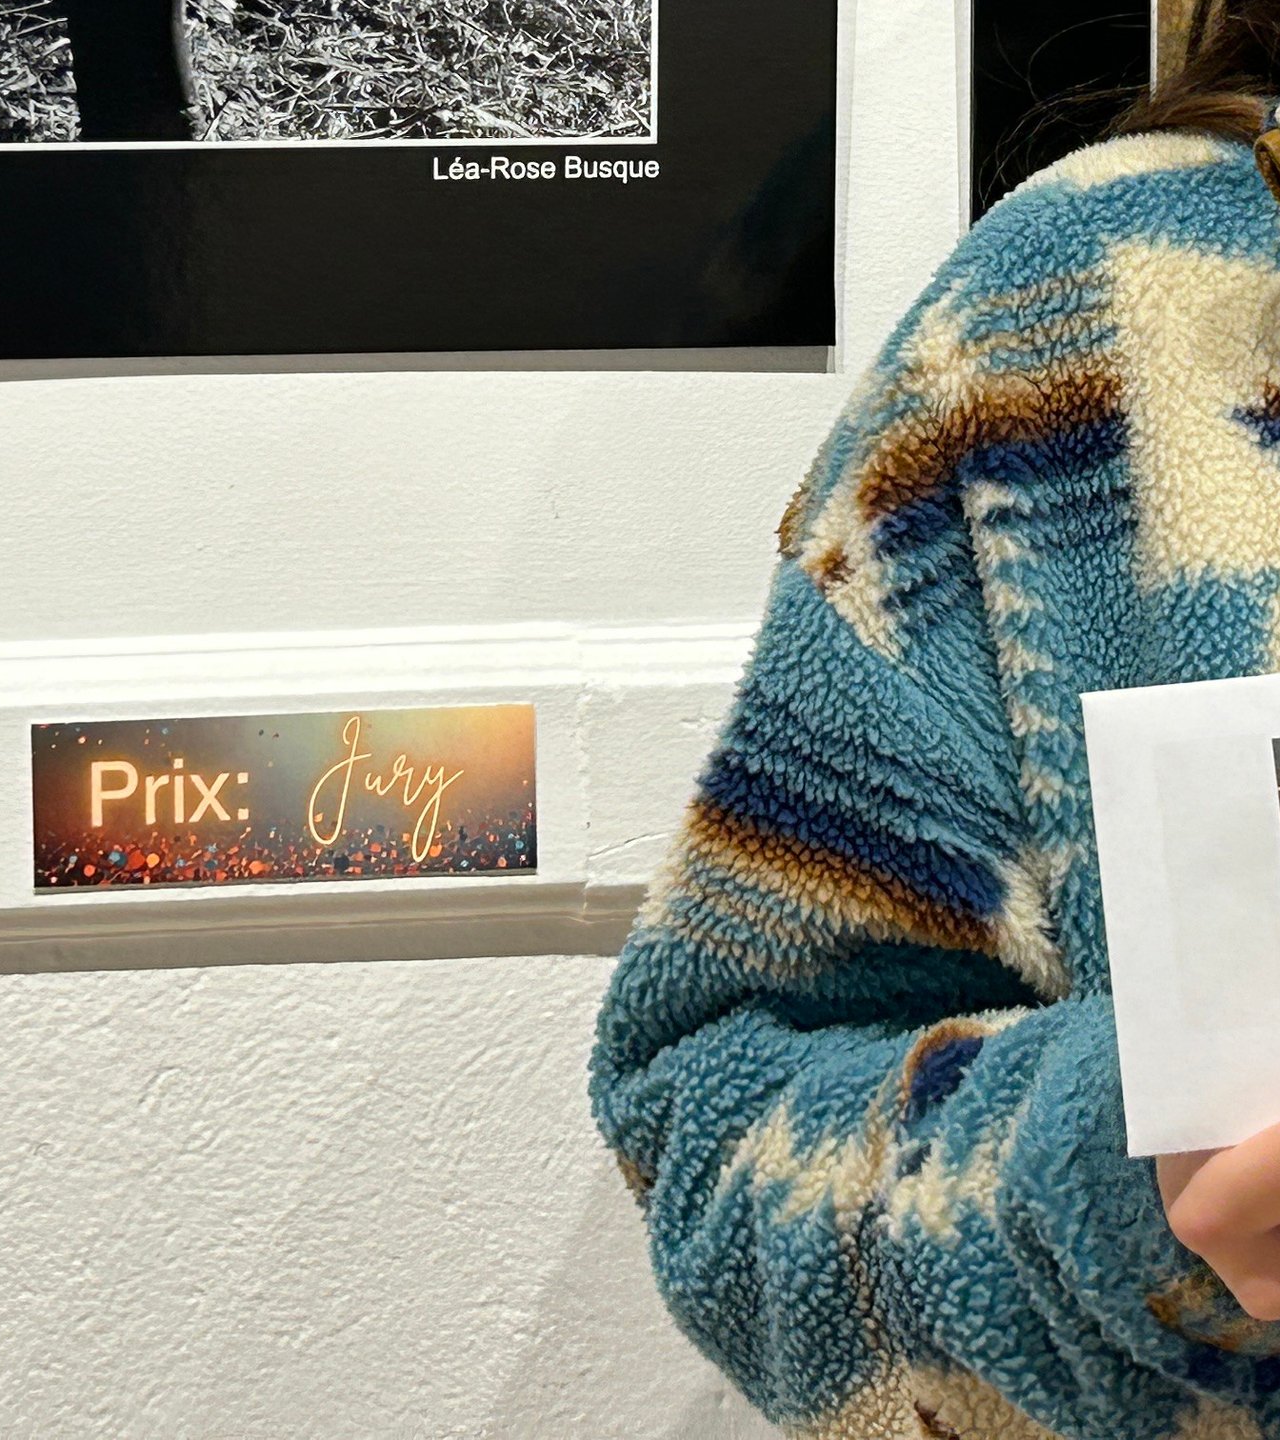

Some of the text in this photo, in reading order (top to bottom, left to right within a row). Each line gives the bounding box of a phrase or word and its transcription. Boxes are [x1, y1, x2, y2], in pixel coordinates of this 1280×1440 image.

[433, 155, 660, 184] Léa-Rose Busque
[91, 716, 465, 863] Prix: Jury
